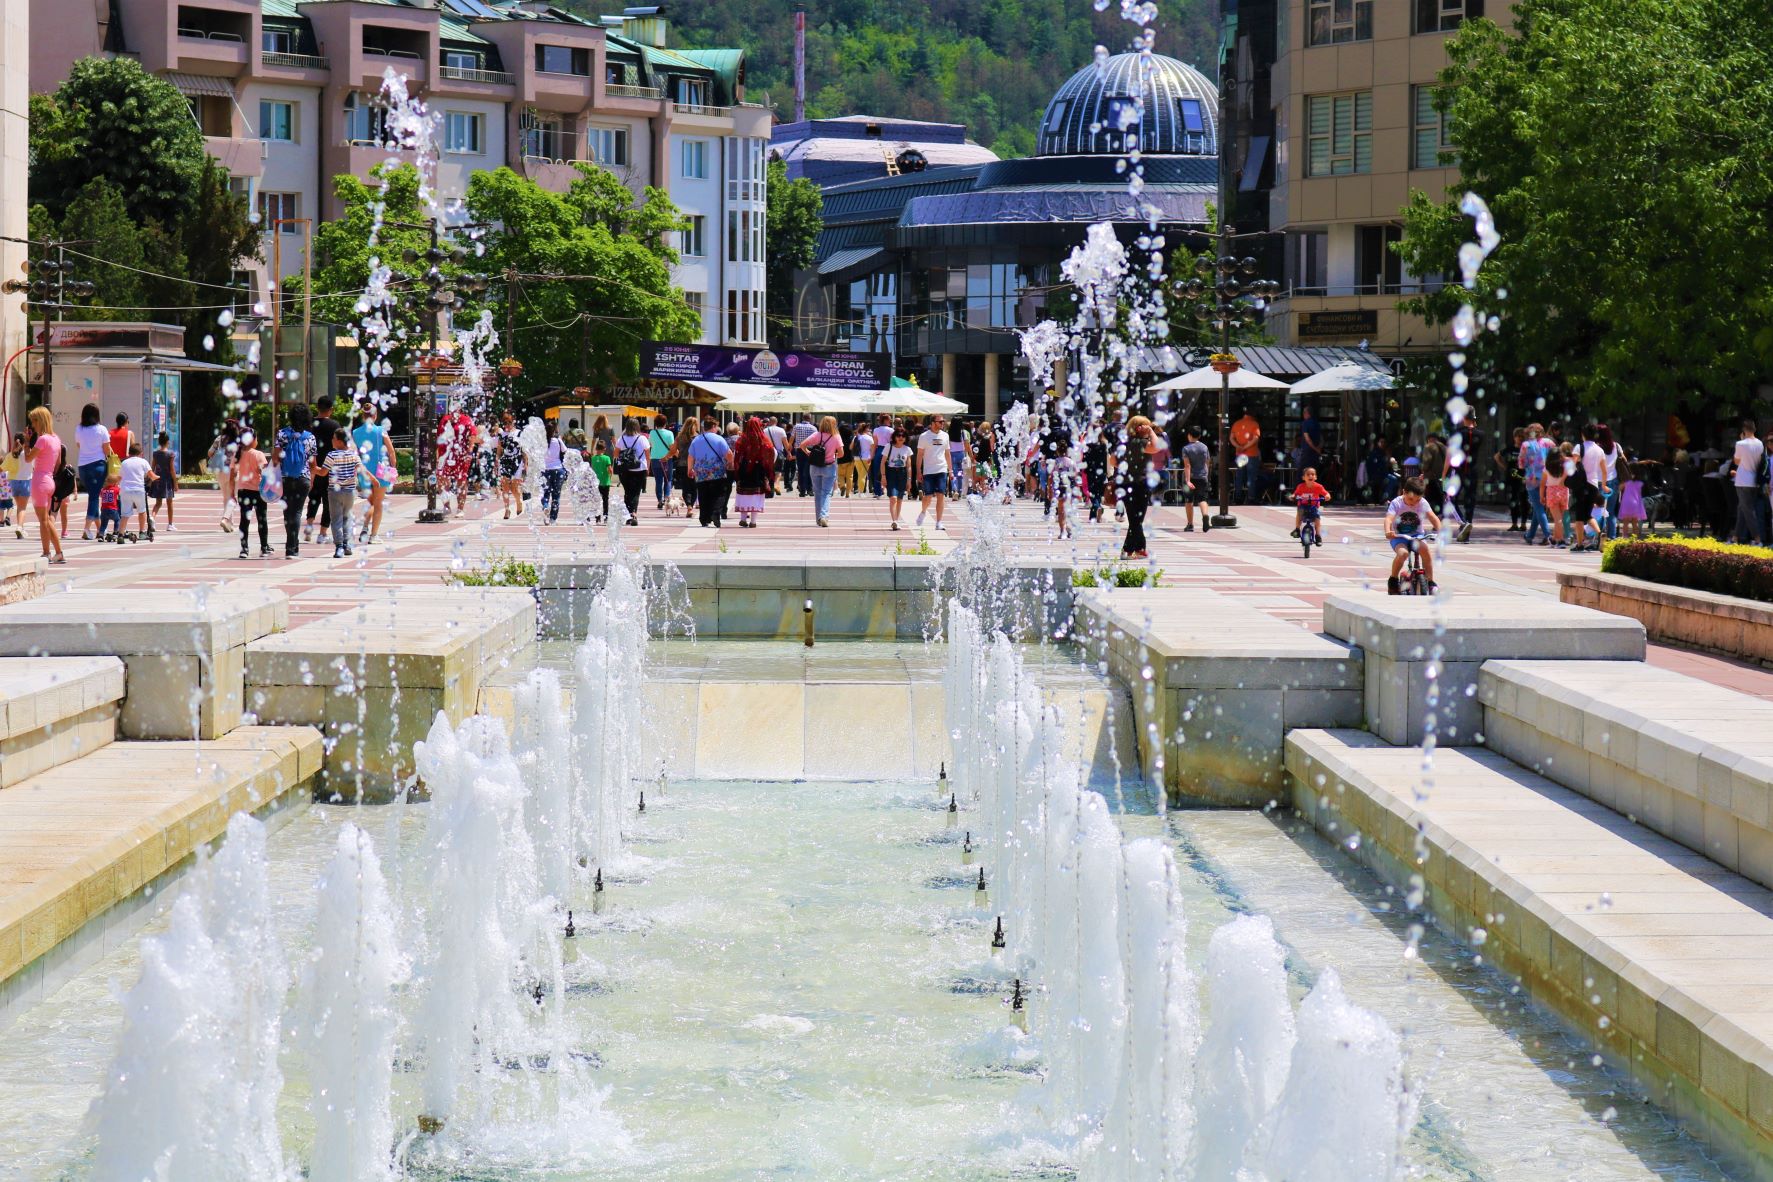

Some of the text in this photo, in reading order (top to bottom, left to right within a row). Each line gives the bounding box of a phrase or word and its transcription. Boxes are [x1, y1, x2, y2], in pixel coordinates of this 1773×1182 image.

[655, 353, 700, 363] ISHTAR
[825, 360, 865, 369] GORAN
[814, 368, 874, 378] BREGOVIĆ
[644, 387, 695, 400] NAPOLI
